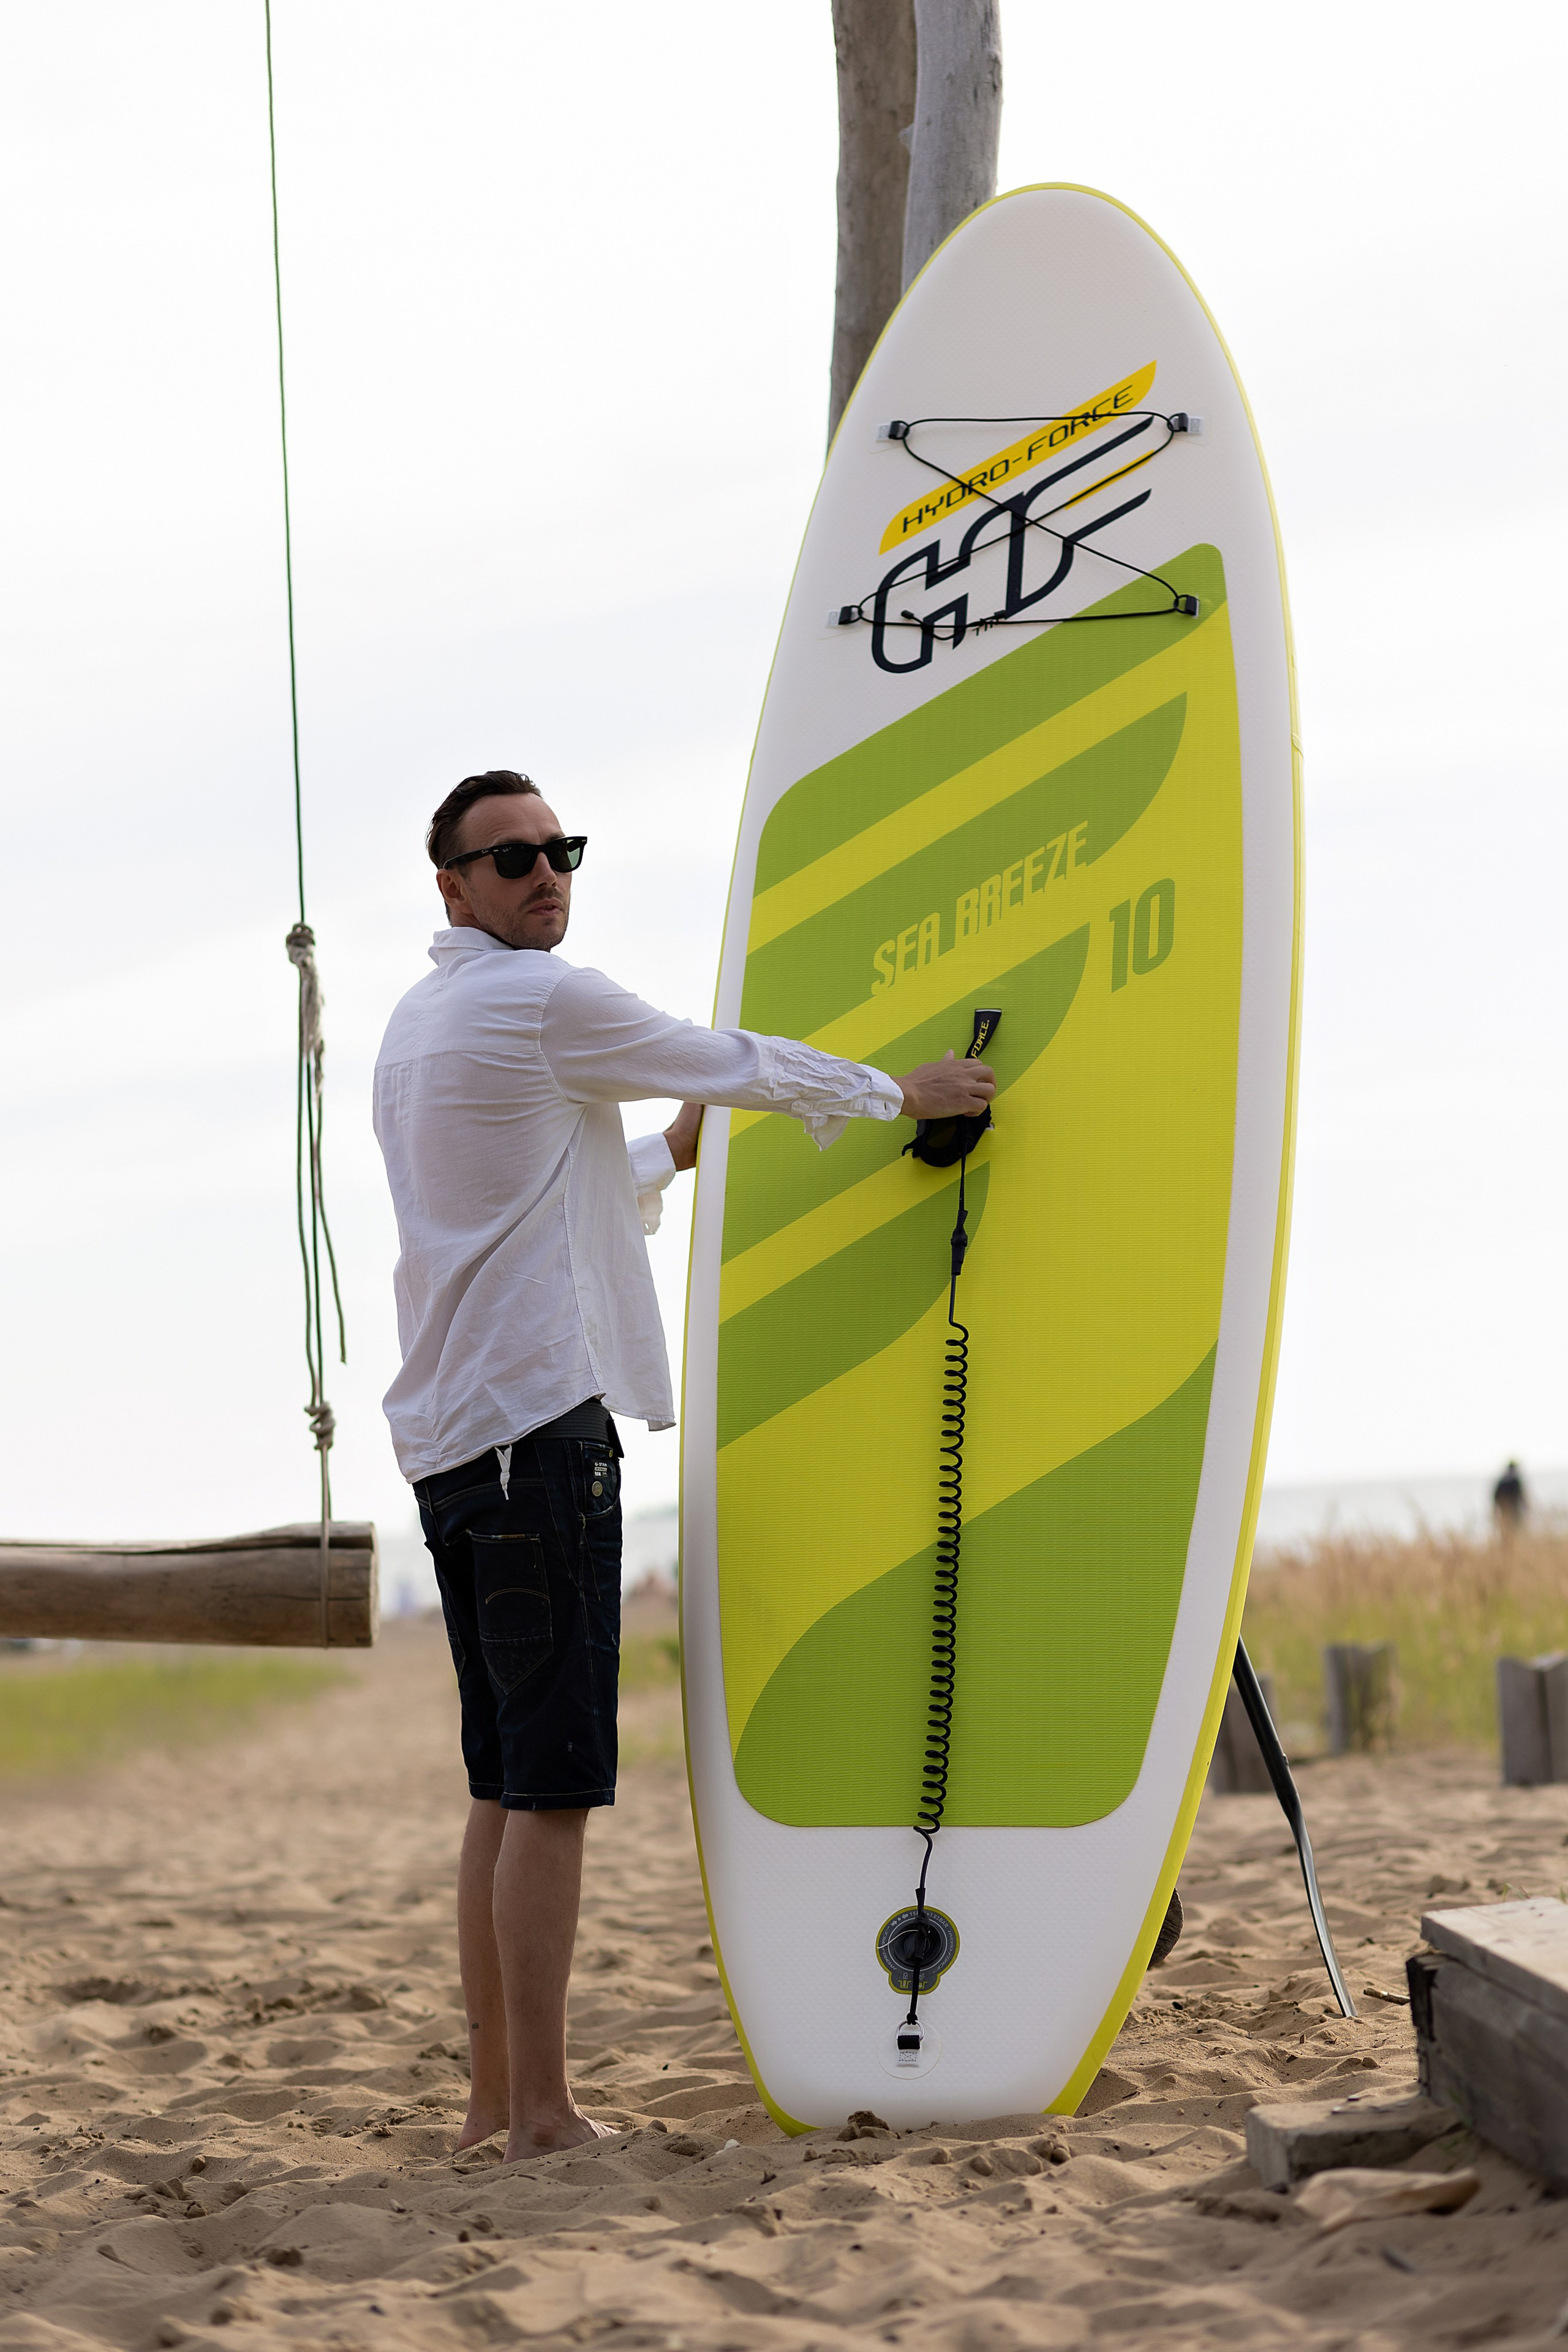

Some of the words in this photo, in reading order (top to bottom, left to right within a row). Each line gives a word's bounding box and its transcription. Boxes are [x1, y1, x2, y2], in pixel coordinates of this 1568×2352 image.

[902, 385, 1133, 533] HYDRO-FORCE
[871, 912, 940, 995] SEA
[955, 820, 1088, 947] BREEZE
[1109, 878, 1175, 993] 10
